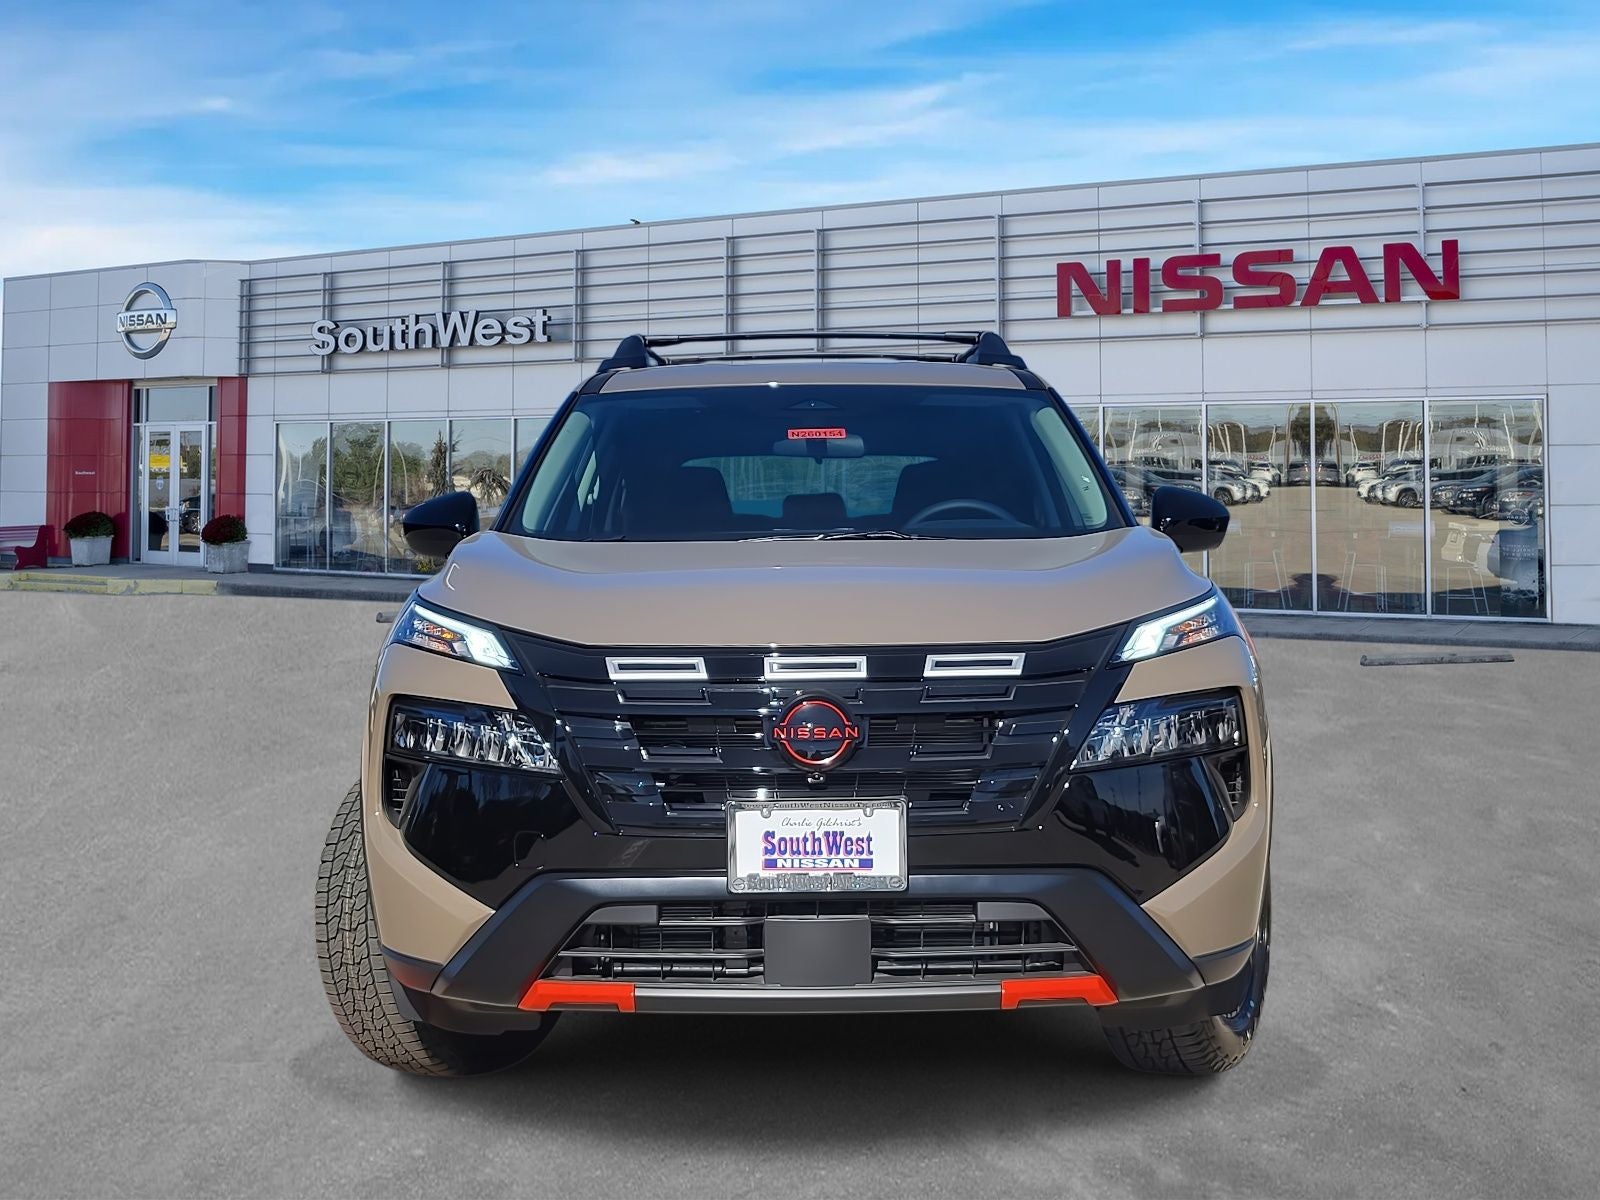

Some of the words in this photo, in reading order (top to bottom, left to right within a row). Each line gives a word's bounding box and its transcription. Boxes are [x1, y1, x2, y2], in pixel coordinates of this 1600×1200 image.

[1056, 239, 1460, 318] NISSAN
[119, 312, 167, 328] NISSAN
[309, 308, 551, 356] SouthWest
[773, 726, 859, 739] NISSAN
[781, 817, 812, 827] Charlie
[816, 817, 862, 831] Gilchrist's
[762, 830, 873, 856] SouthWest
[777, 858, 860, 868] NISSAN
